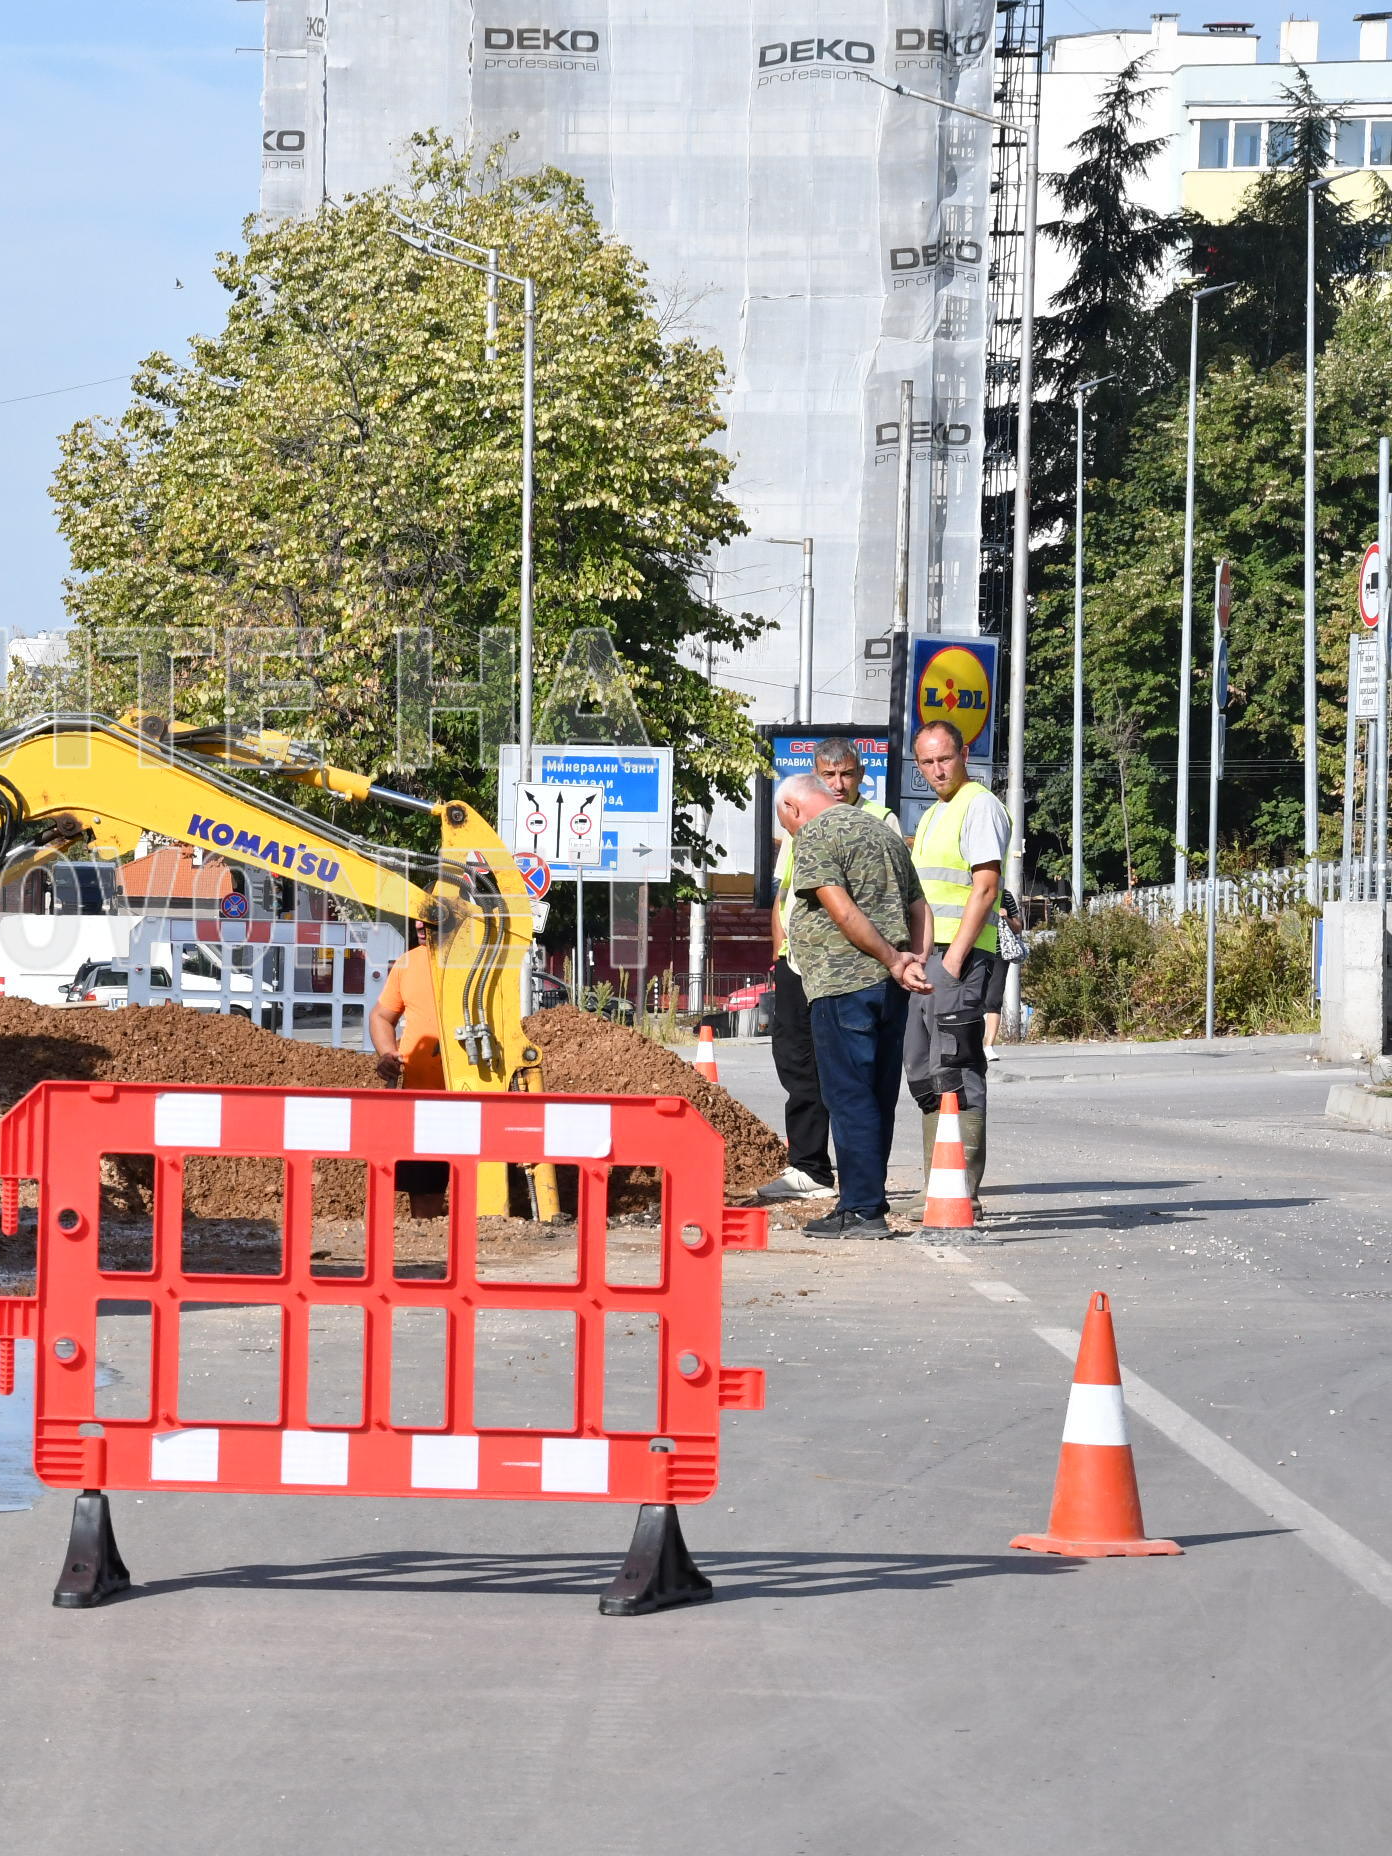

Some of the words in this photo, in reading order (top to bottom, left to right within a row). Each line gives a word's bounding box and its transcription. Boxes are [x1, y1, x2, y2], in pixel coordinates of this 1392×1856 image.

[484, 27, 599, 53] DEKO
[484, 56, 600, 72] professional
[759, 38, 875, 68] DEKO
[757, 68, 873, 89] professiona
[546, 760, 618, 775] Минерални
[624, 759, 655, 774] бани
[187, 813, 341, 883] KOMATSU
